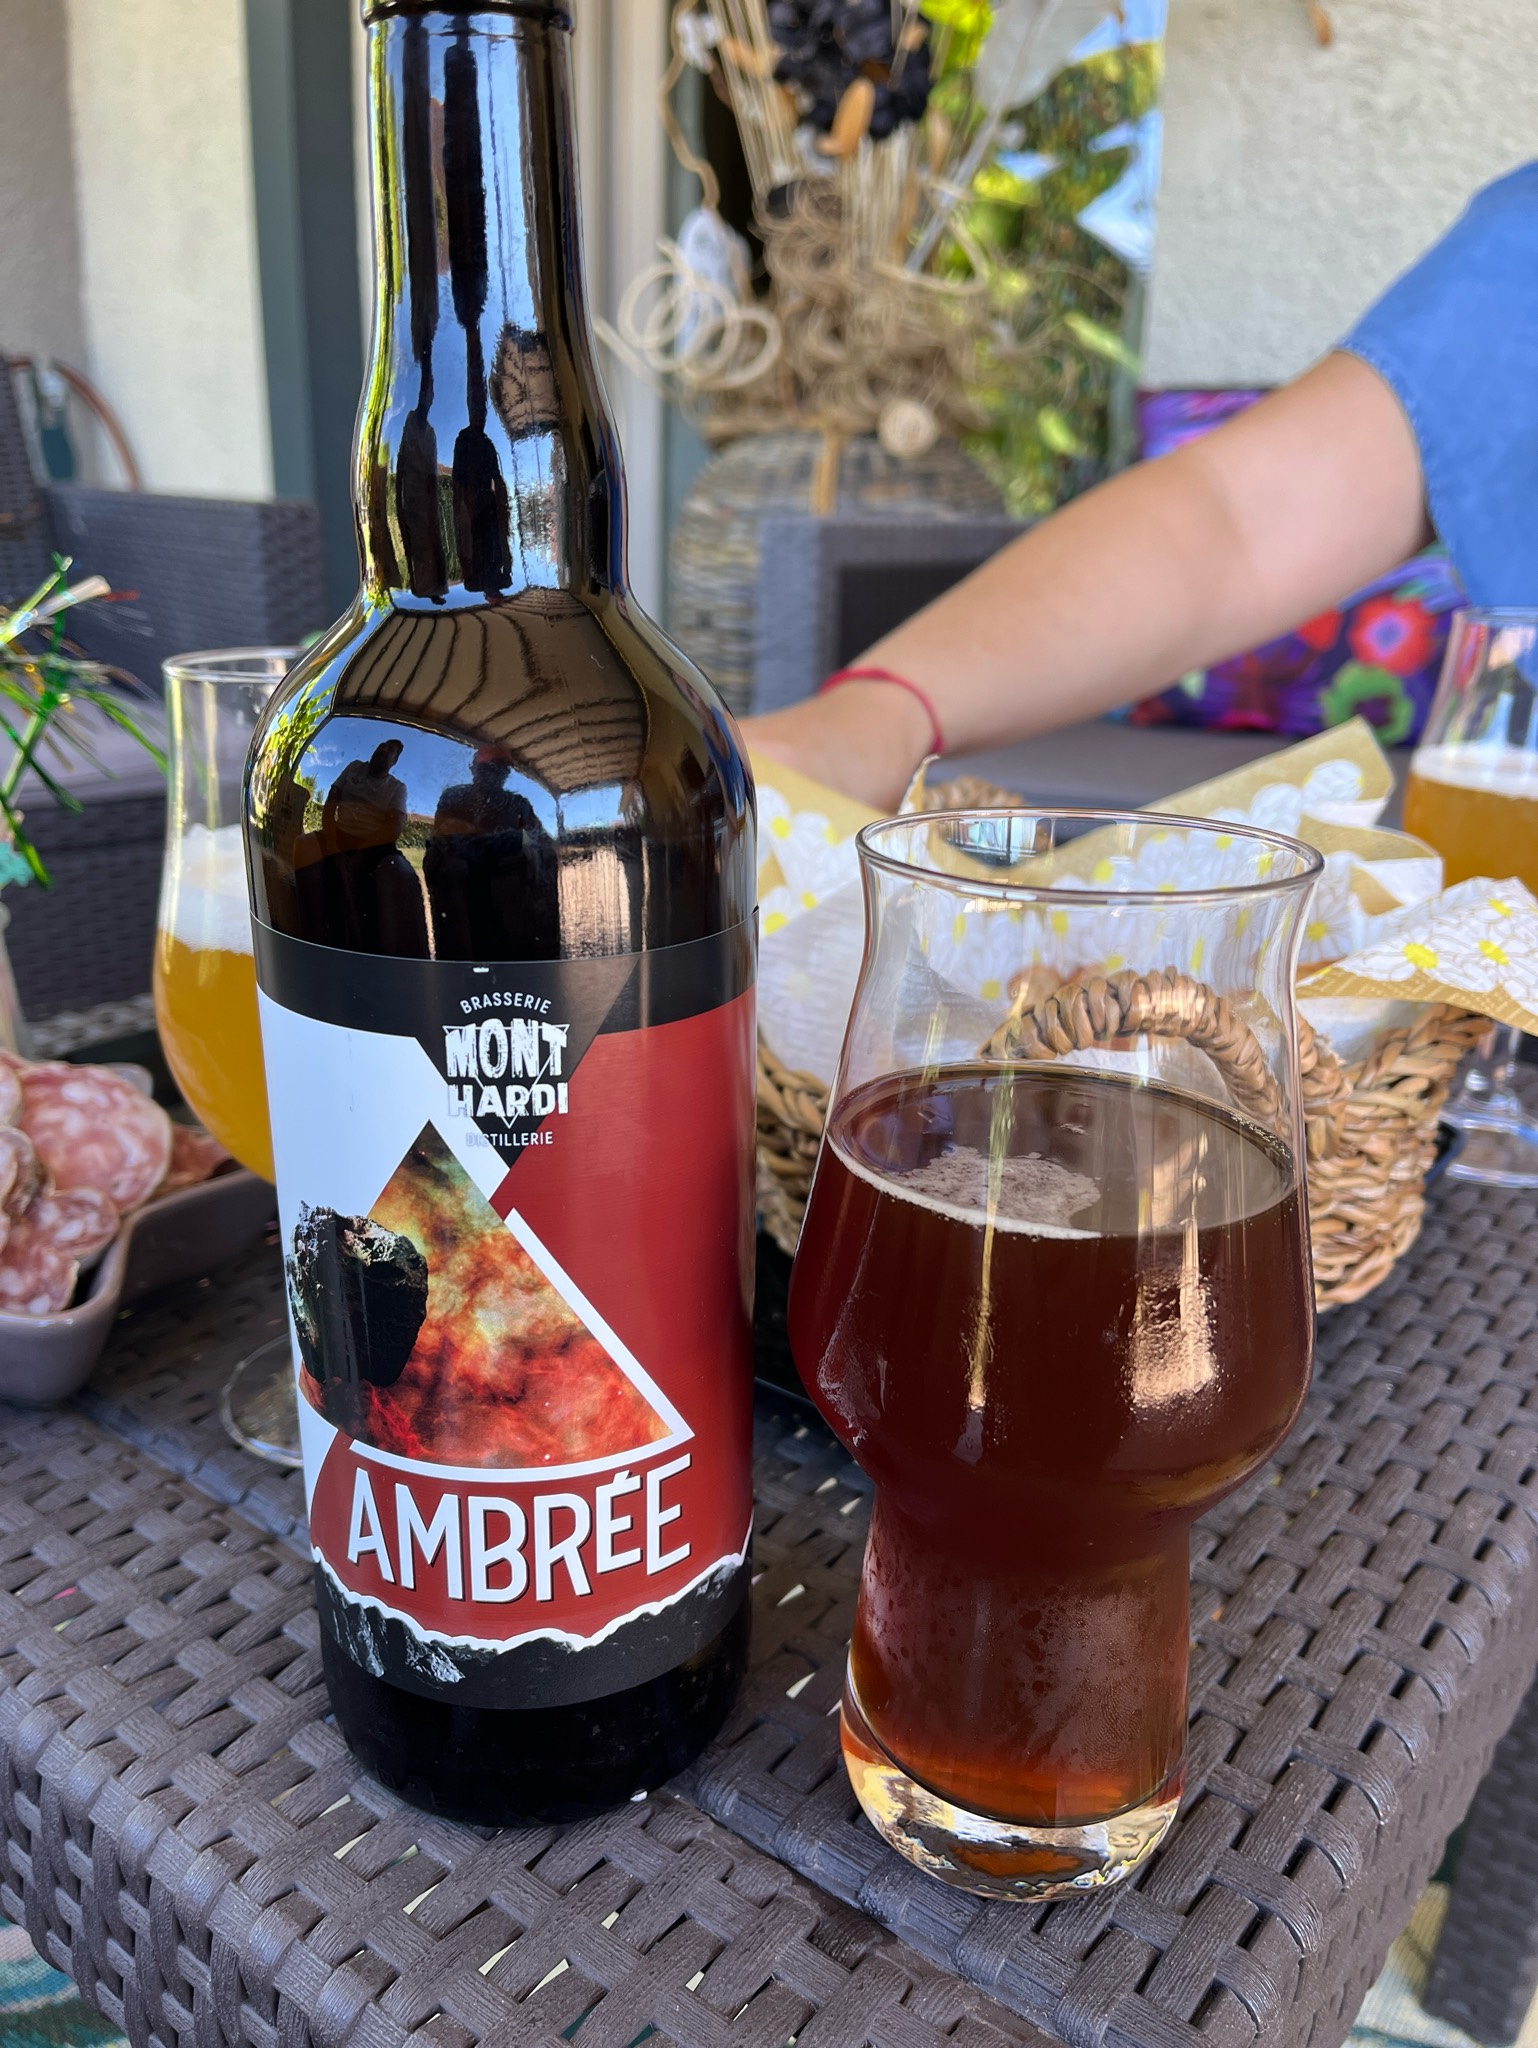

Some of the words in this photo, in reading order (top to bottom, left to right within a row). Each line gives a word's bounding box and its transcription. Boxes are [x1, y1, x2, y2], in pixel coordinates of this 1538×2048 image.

[460, 992, 551, 1014] BRASSERIE
[445, 1018, 567, 1078] MONT
[448, 1082, 569, 1117] HARDI
[466, 1131, 553, 1147] DISTILLERIE
[347, 1453, 692, 1603] AMBRÉE
